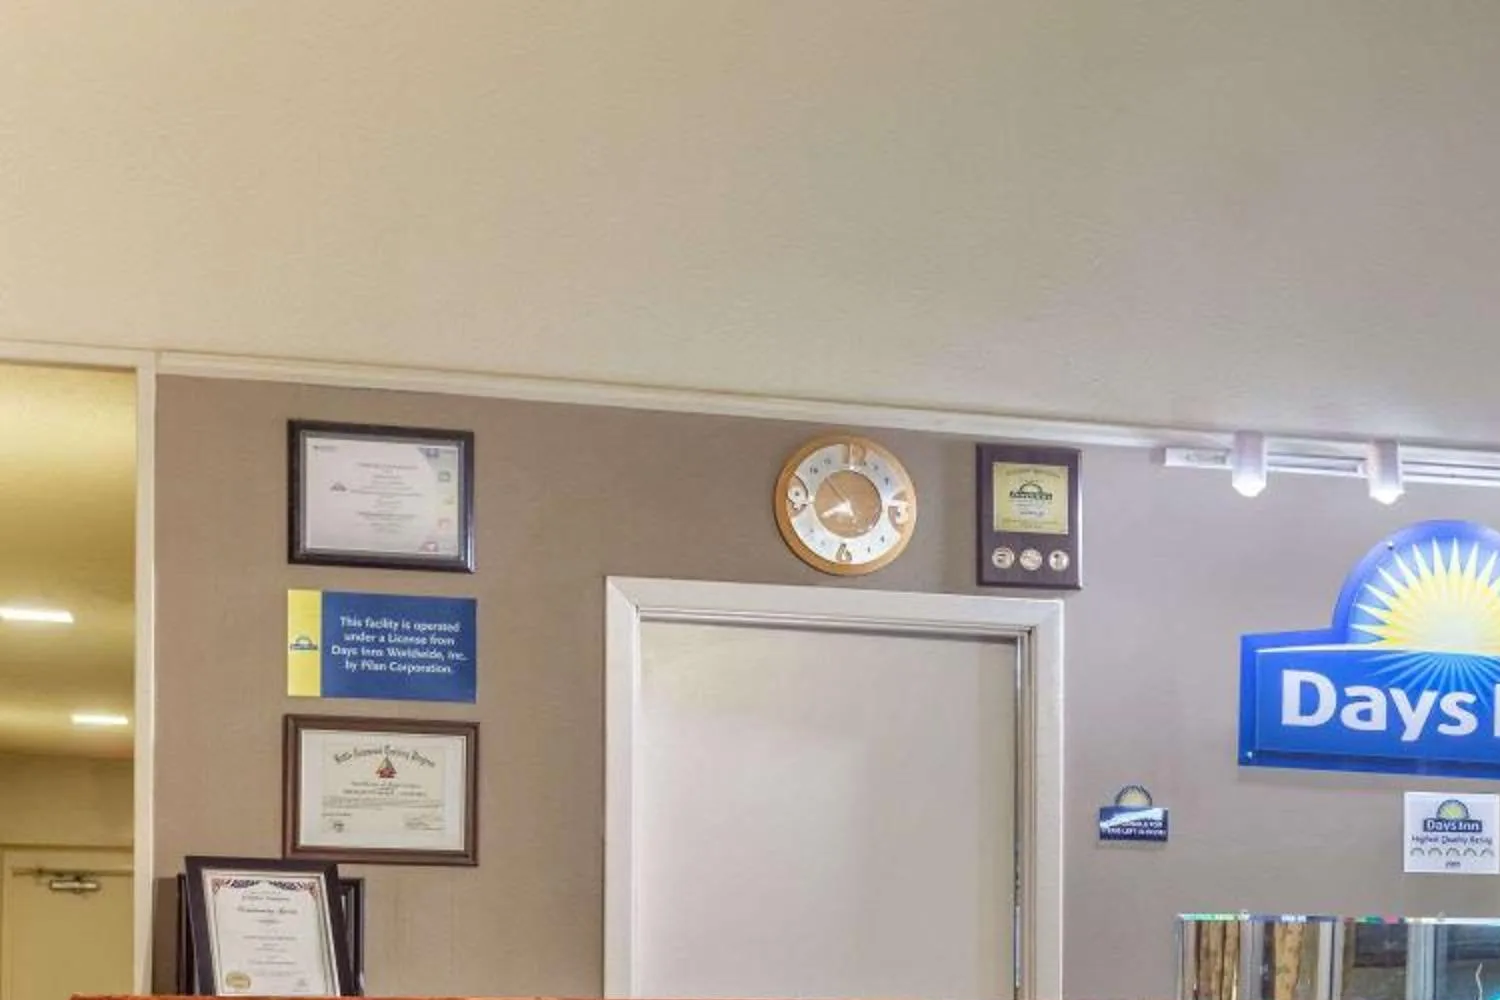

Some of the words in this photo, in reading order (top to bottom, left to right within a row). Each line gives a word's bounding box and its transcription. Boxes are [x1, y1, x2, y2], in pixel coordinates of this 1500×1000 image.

[340, 616, 362, 628] This
[365, 616, 399, 631] facility
[401, 619, 411, 629] is
[413, 621, 461, 633] operated
[344, 632, 376, 642] under
[379, 635, 385, 643] a
[387, 633, 427, 645] License
[430, 633, 455, 646] from
[331, 645, 358, 657] Days
[345, 659, 357, 672] by
[1281, 668, 1479, 742] Days
[1427, 820, 1457, 831] Days
[1459, 821, 1480, 831] Inn
